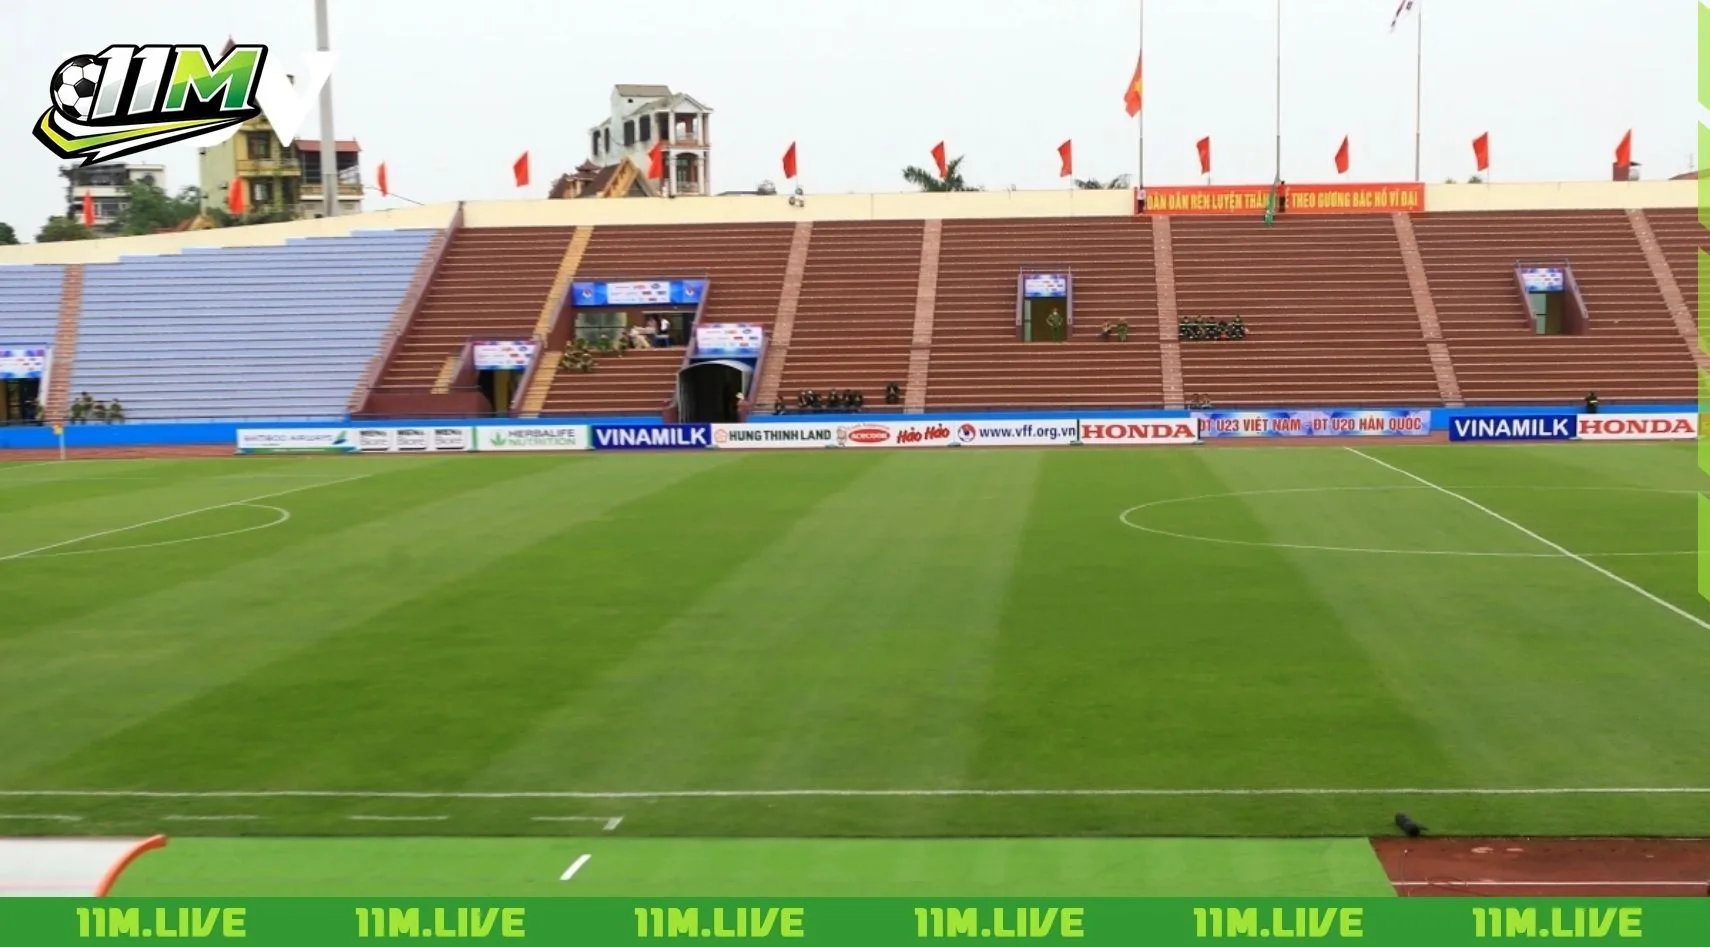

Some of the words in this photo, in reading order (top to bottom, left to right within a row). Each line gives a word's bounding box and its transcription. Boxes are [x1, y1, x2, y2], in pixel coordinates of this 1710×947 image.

[1291, 191, 1316, 208] THEO
[1353, 188, 1372, 208] BÁC
[1082, 424, 1195, 438] HONDA
[1216, 418, 1239, 431] U23
[1243, 416, 1268, 433] VIỆT
[1332, 418, 1354, 430] U20
[1455, 419, 1568, 437] VINAMILK
[1579, 419, 1694, 434] HONDA
[509, 429, 574, 437] HERBALIFE
[597, 428, 708, 446] VINAMILK
[729, 431, 762, 441] HUNG
[801, 429, 831, 441] LAND
[979, 425, 1075, 439] www.vff.org.vn
[509, 437, 575, 446] NUTRITION
